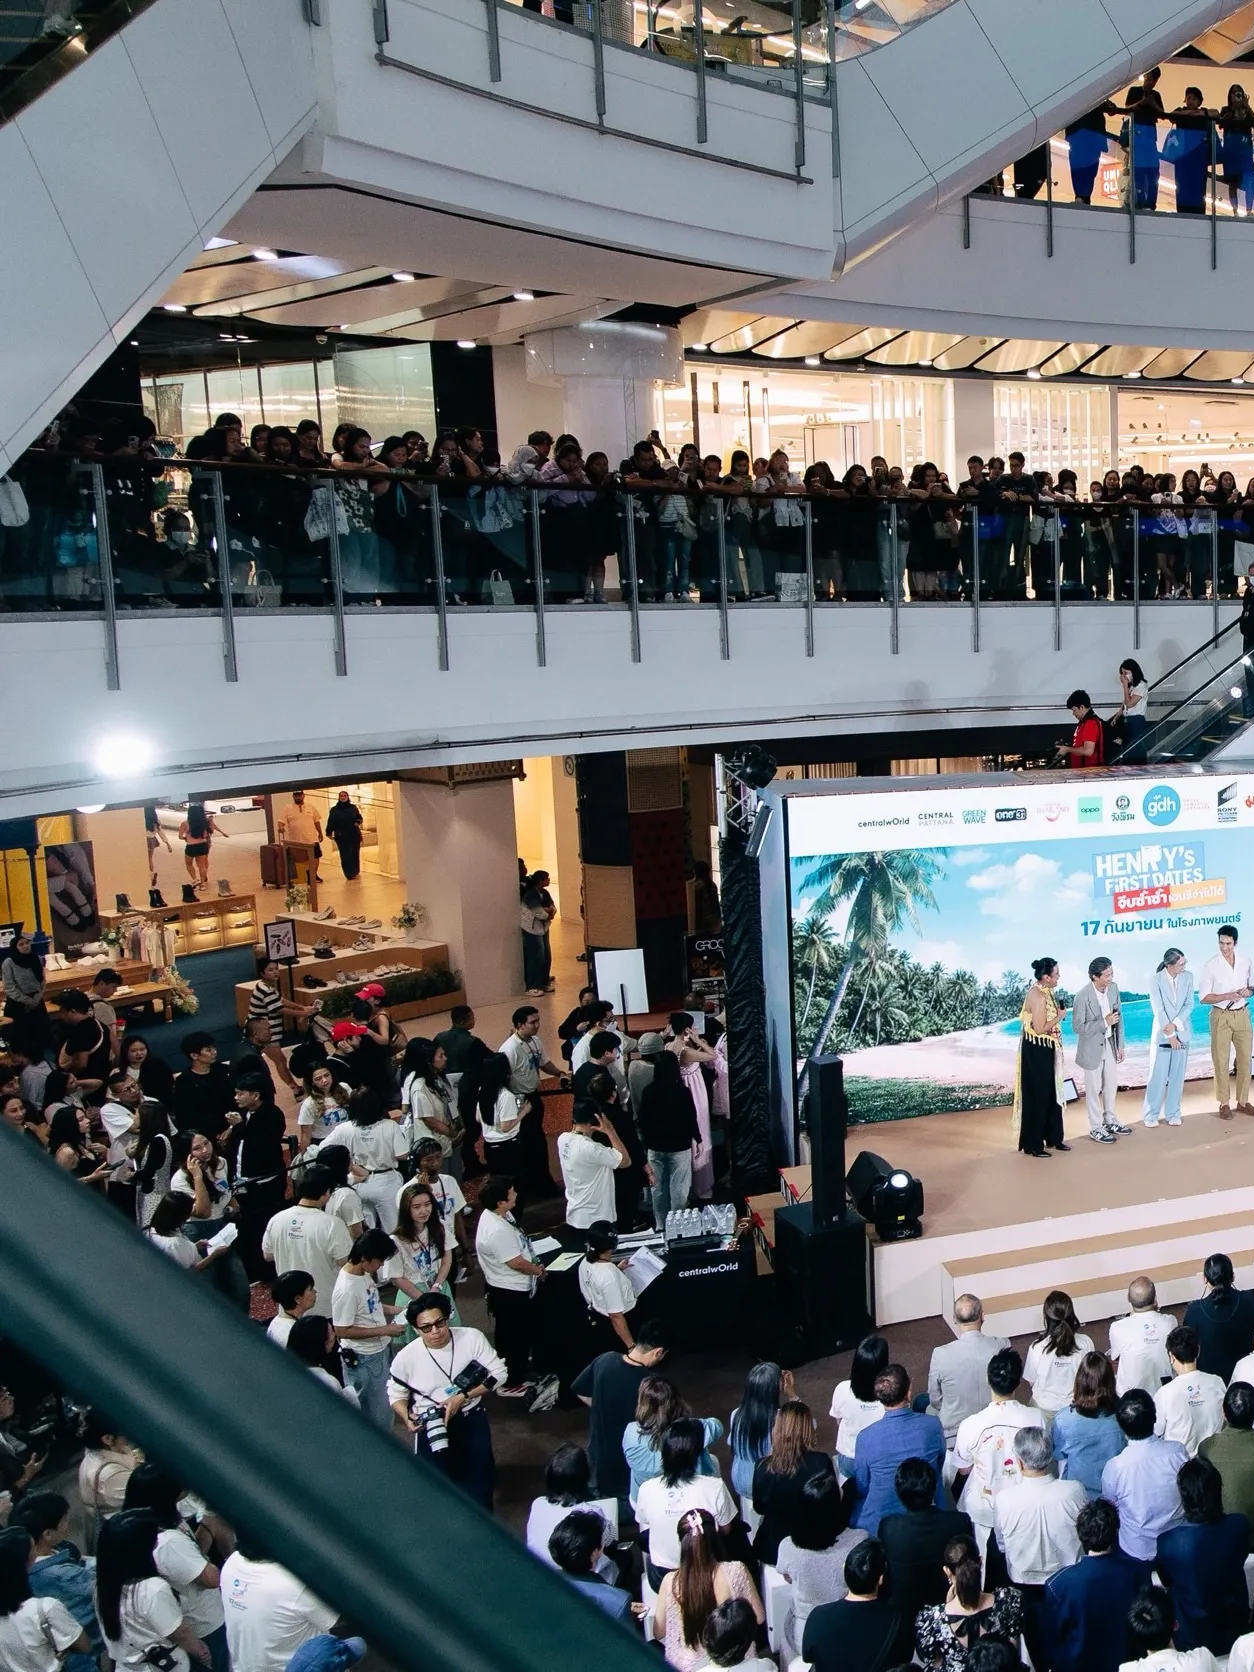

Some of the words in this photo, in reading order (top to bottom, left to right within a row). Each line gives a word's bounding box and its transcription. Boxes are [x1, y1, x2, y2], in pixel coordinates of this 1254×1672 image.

[1080, 806, 1100, 814] oppo
[1147, 796, 1177, 817] gdh
[918, 811, 954, 820] CENTRAL
[962, 809, 987, 817] GREEN
[858, 817, 910, 828] centralwOrld
[918, 819, 954, 828] PATTANA
[963, 816, 986, 825] WAVE
[1152, 868, 1204, 888] DATES
[1081, 920, 1101, 936] 17
[1104, 918, 1163, 935] กันยายน
[1167, 912, 1242, 929] ในโรงภาพยนตร์
[678, 1261, 739, 1278] centralwOrld
